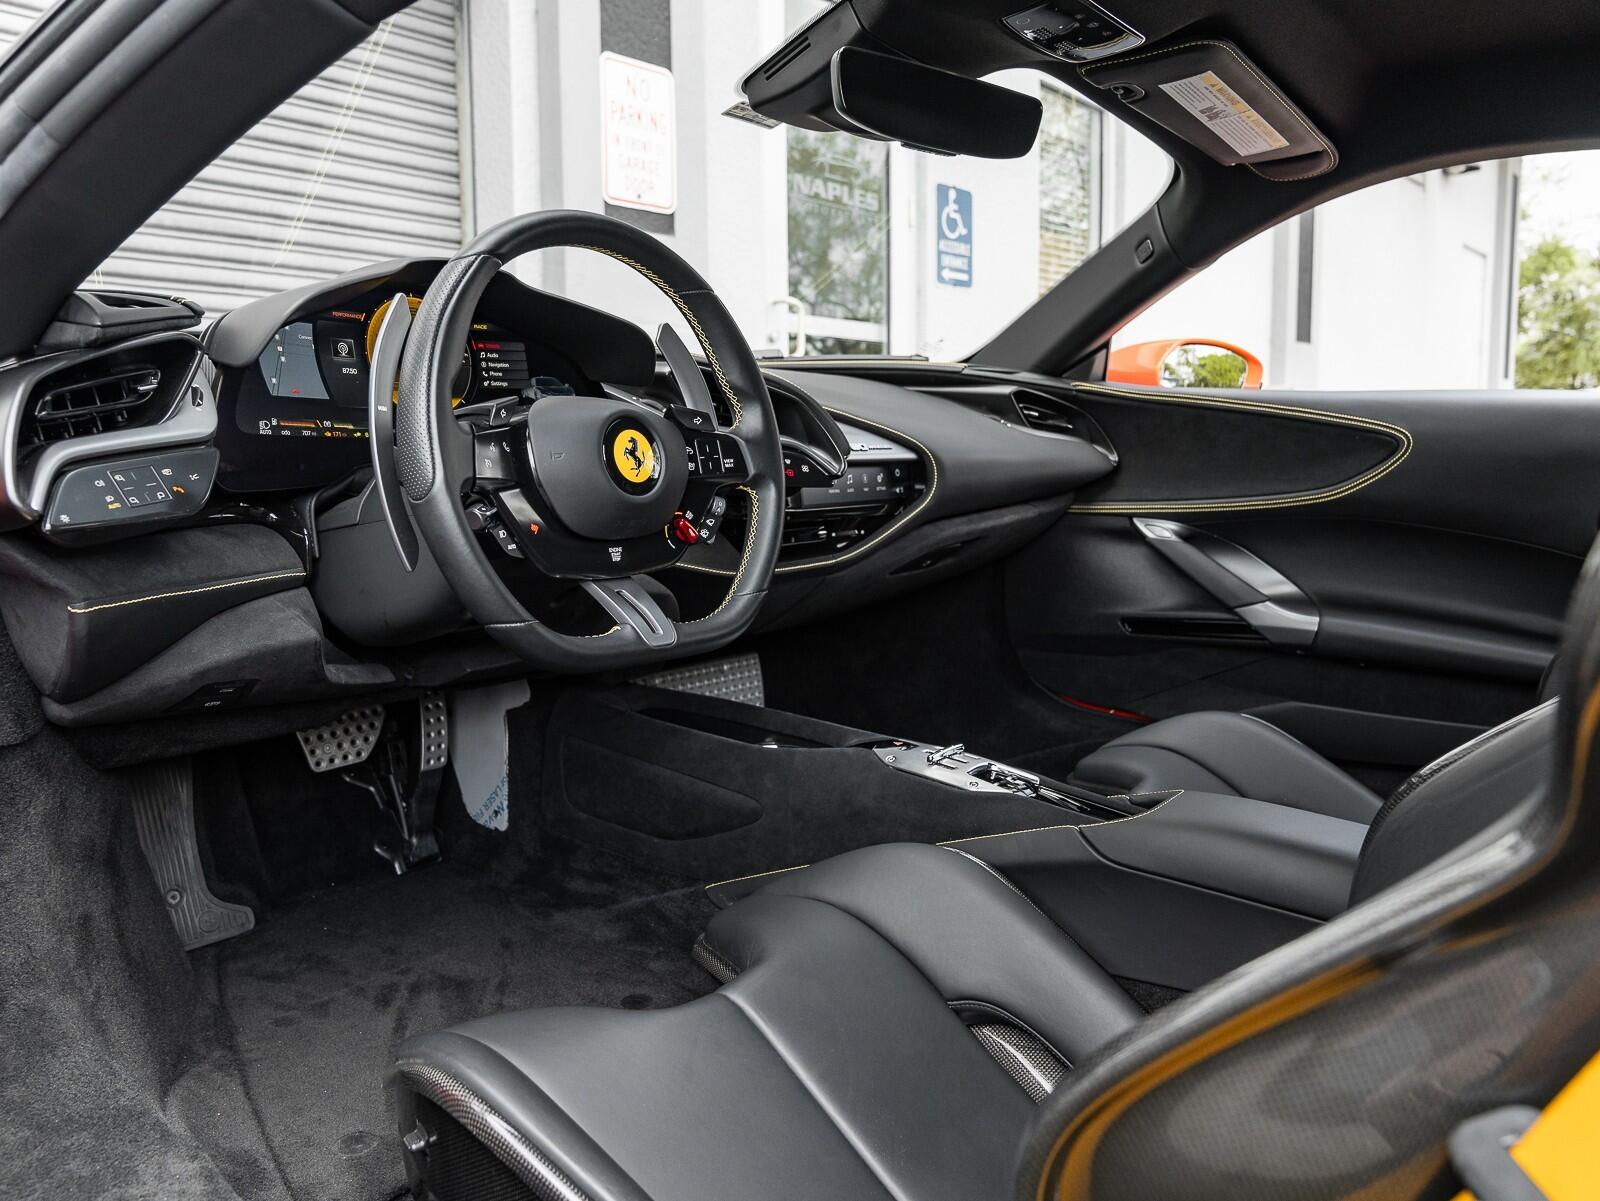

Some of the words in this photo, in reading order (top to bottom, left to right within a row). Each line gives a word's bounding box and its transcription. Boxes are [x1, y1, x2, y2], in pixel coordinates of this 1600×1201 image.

[793, 173, 879, 211] NAPLES
[487, 361, 510, 370] Navigation
[490, 380, 509, 388] Settings
